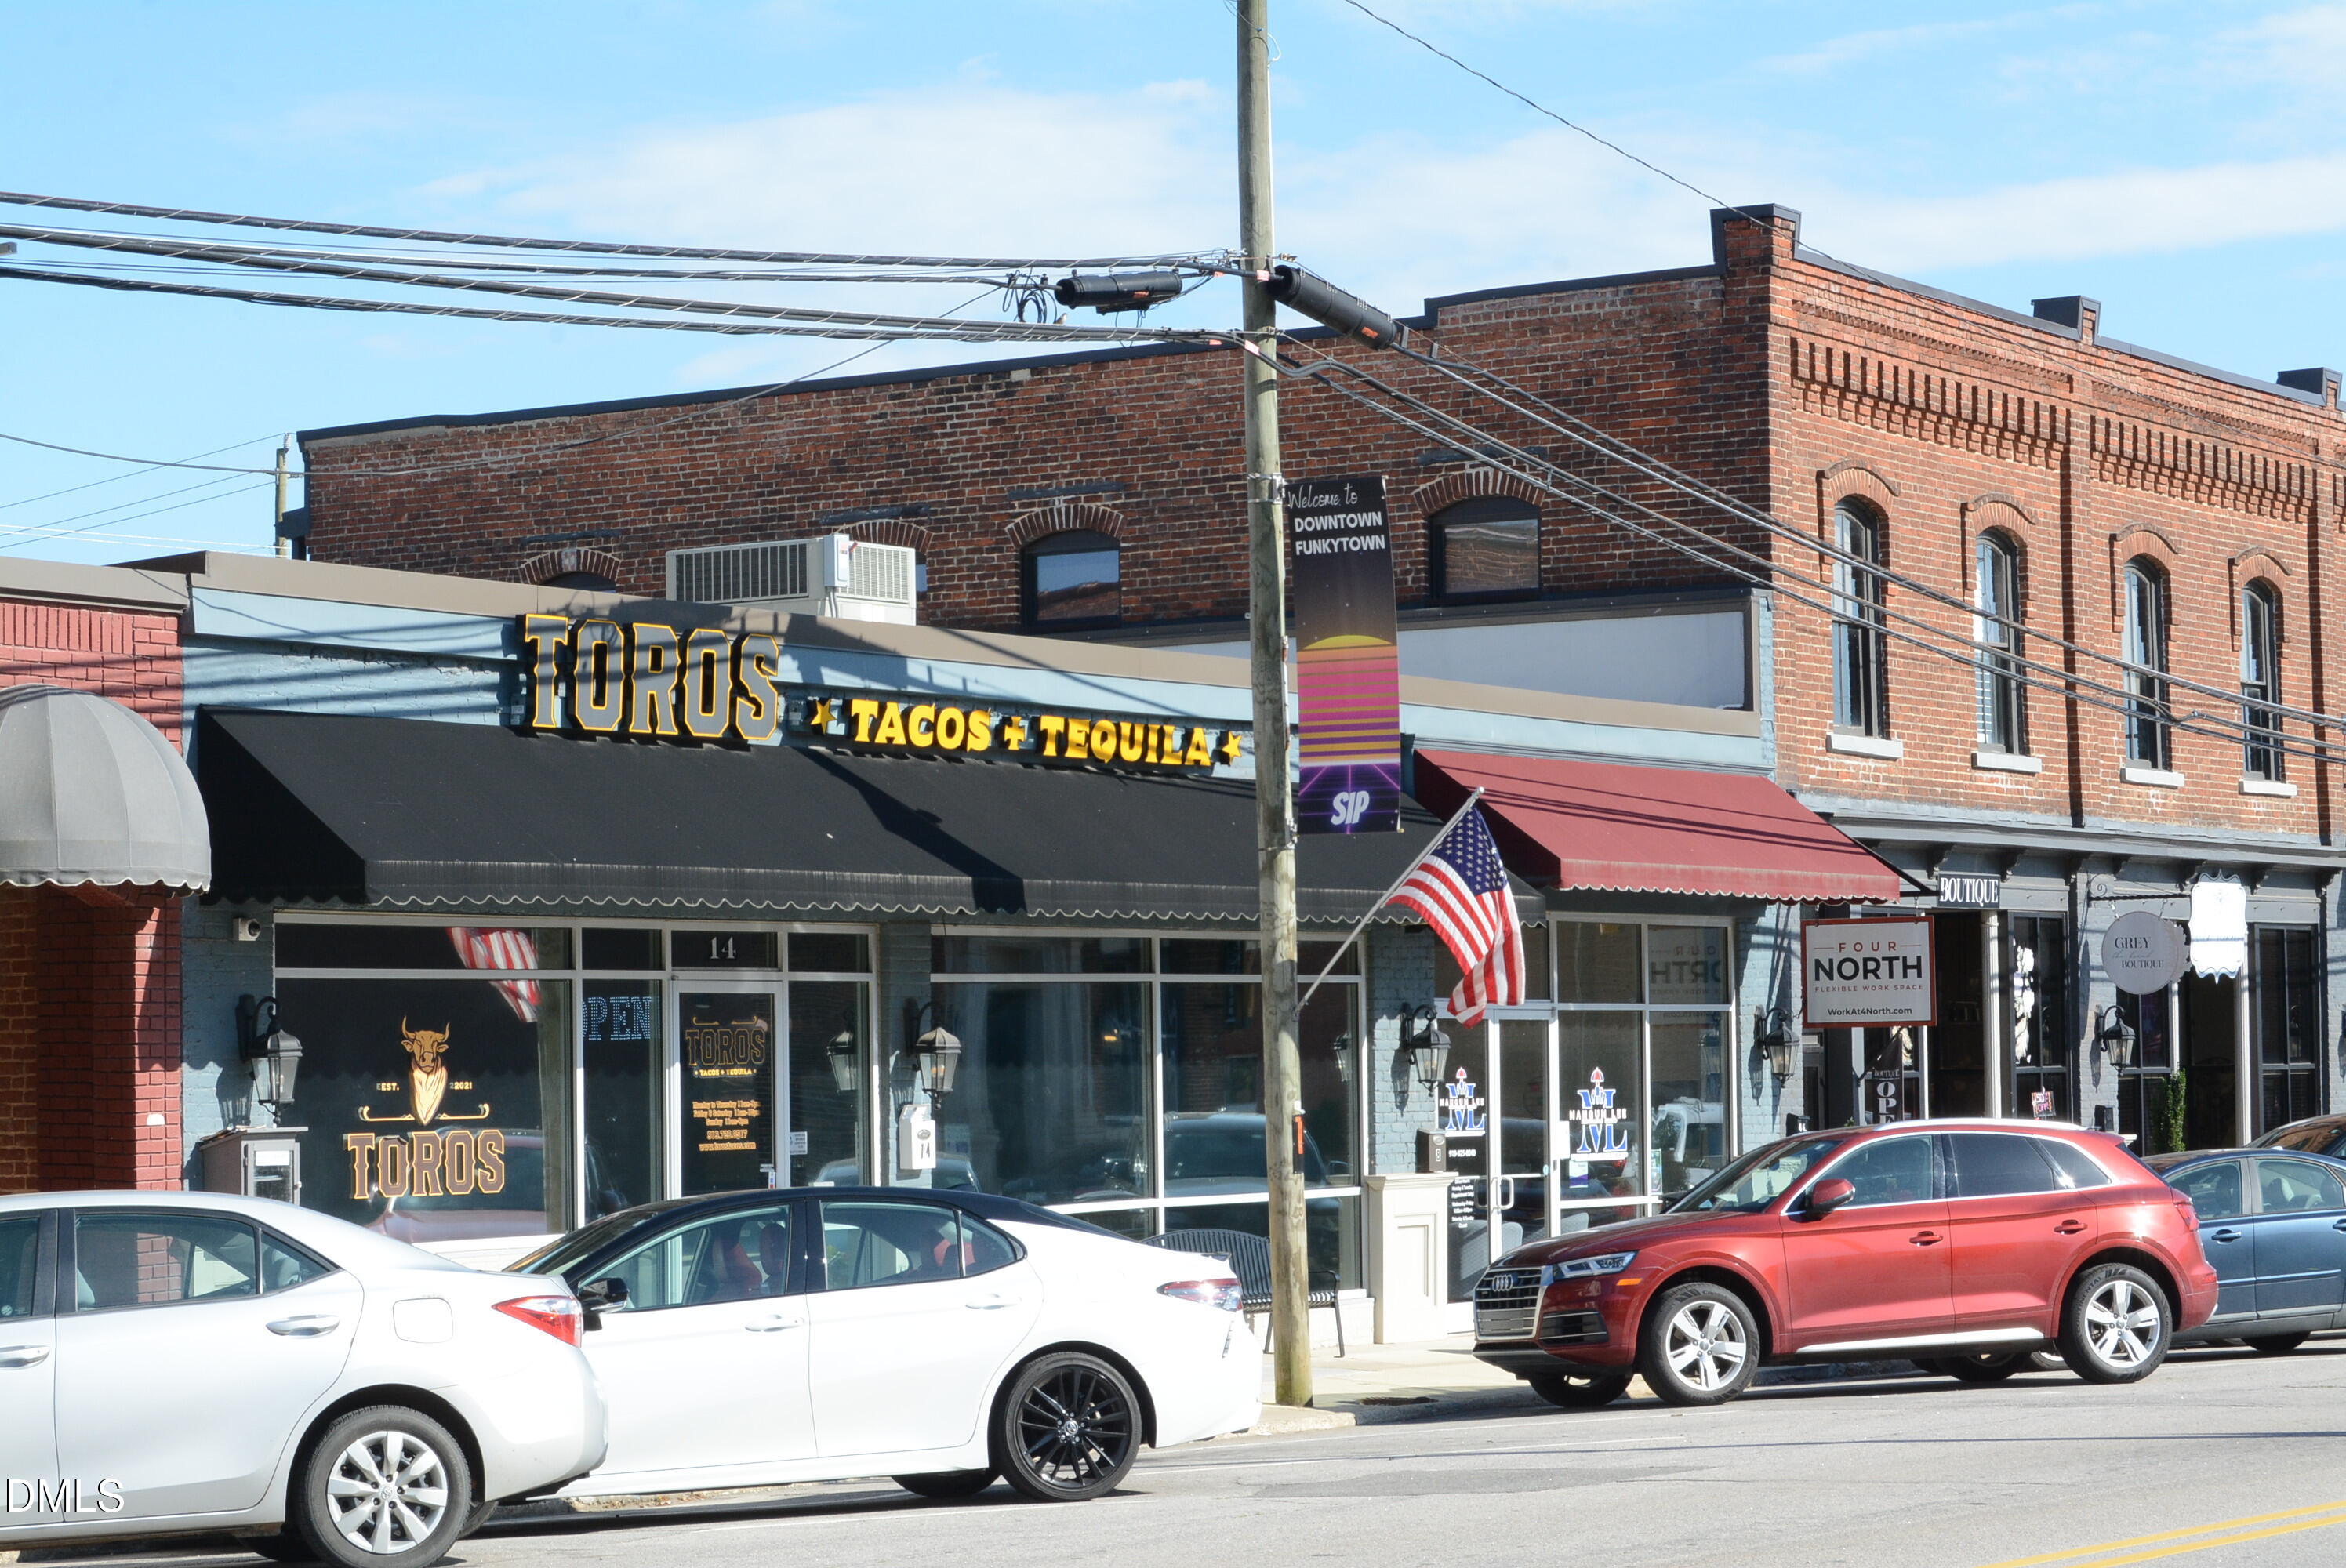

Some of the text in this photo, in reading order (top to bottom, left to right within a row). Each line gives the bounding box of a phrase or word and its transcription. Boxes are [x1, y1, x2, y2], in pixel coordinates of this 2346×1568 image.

[1287, 482, 1358, 509] Welcome to
[1294, 510, 1383, 533] DOWNTOWN
[1295, 535, 1386, 556] FUNKYTOWN
[525, 612, 779, 740] TOROS
[850, 698, 993, 753] TACOS
[1039, 714, 1212, 768] TEQUILA
[1330, 790, 1371, 826] SIP
[1939, 877, 1999, 908] BOUTIQUE
[710, 935, 737, 960] 14
[1838, 940, 1898, 953] FOUR
[2115, 936, 2152, 949] GREY
[1814, 955, 1923, 982] NORTH
[2121, 960, 2165, 970] BOUTIQUE
[1814, 985, 1858, 993] FLEXIBLE
[582, 996, 652, 1041] PEN
[1827, 1006, 1913, 1016] WorkAt4North.com
[685, 1028, 767, 1067] TOROS
[699, 1068, 720, 1076] TACOS
[726, 1068, 753, 1076] TEQUILA
[381, 1081, 473, 1092] EST. 2021
[920, 1142, 931, 1159] 14
[347, 1128, 505, 1200] TOROS
